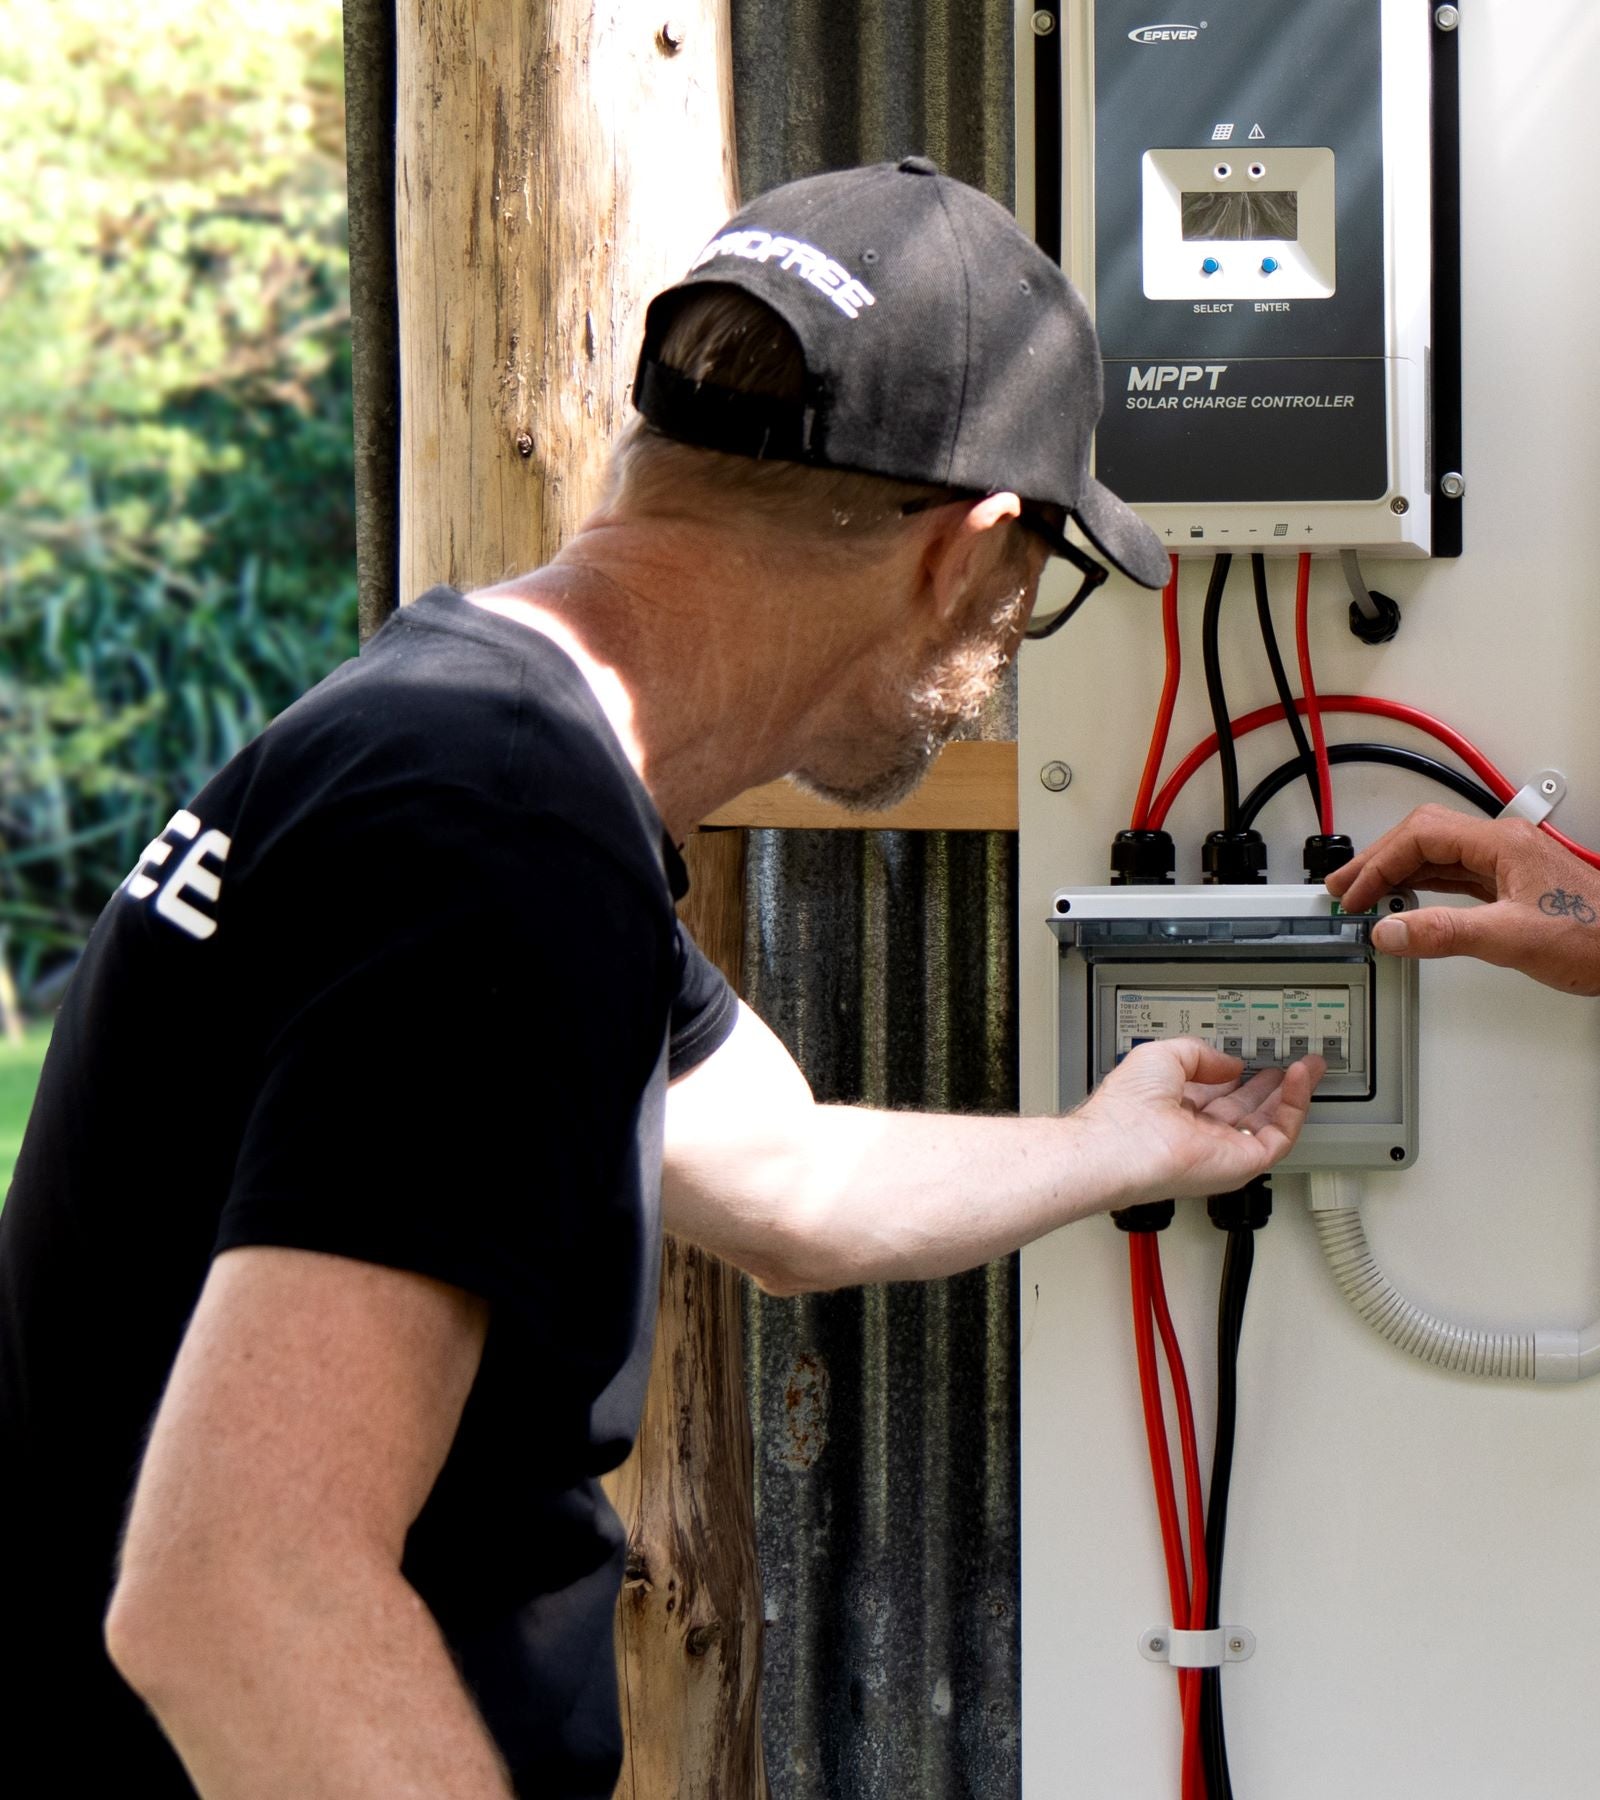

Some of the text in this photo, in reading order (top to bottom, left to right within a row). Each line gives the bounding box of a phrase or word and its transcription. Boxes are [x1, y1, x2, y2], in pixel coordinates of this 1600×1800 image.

[1143, 30, 1198, 41] EPEVER
[1193, 302, 1290, 313] SELECT ENTER
[1127, 365, 1228, 391] MPPT
[1126, 395, 1355, 409] SOLAR CHARGE CONTROLLER
